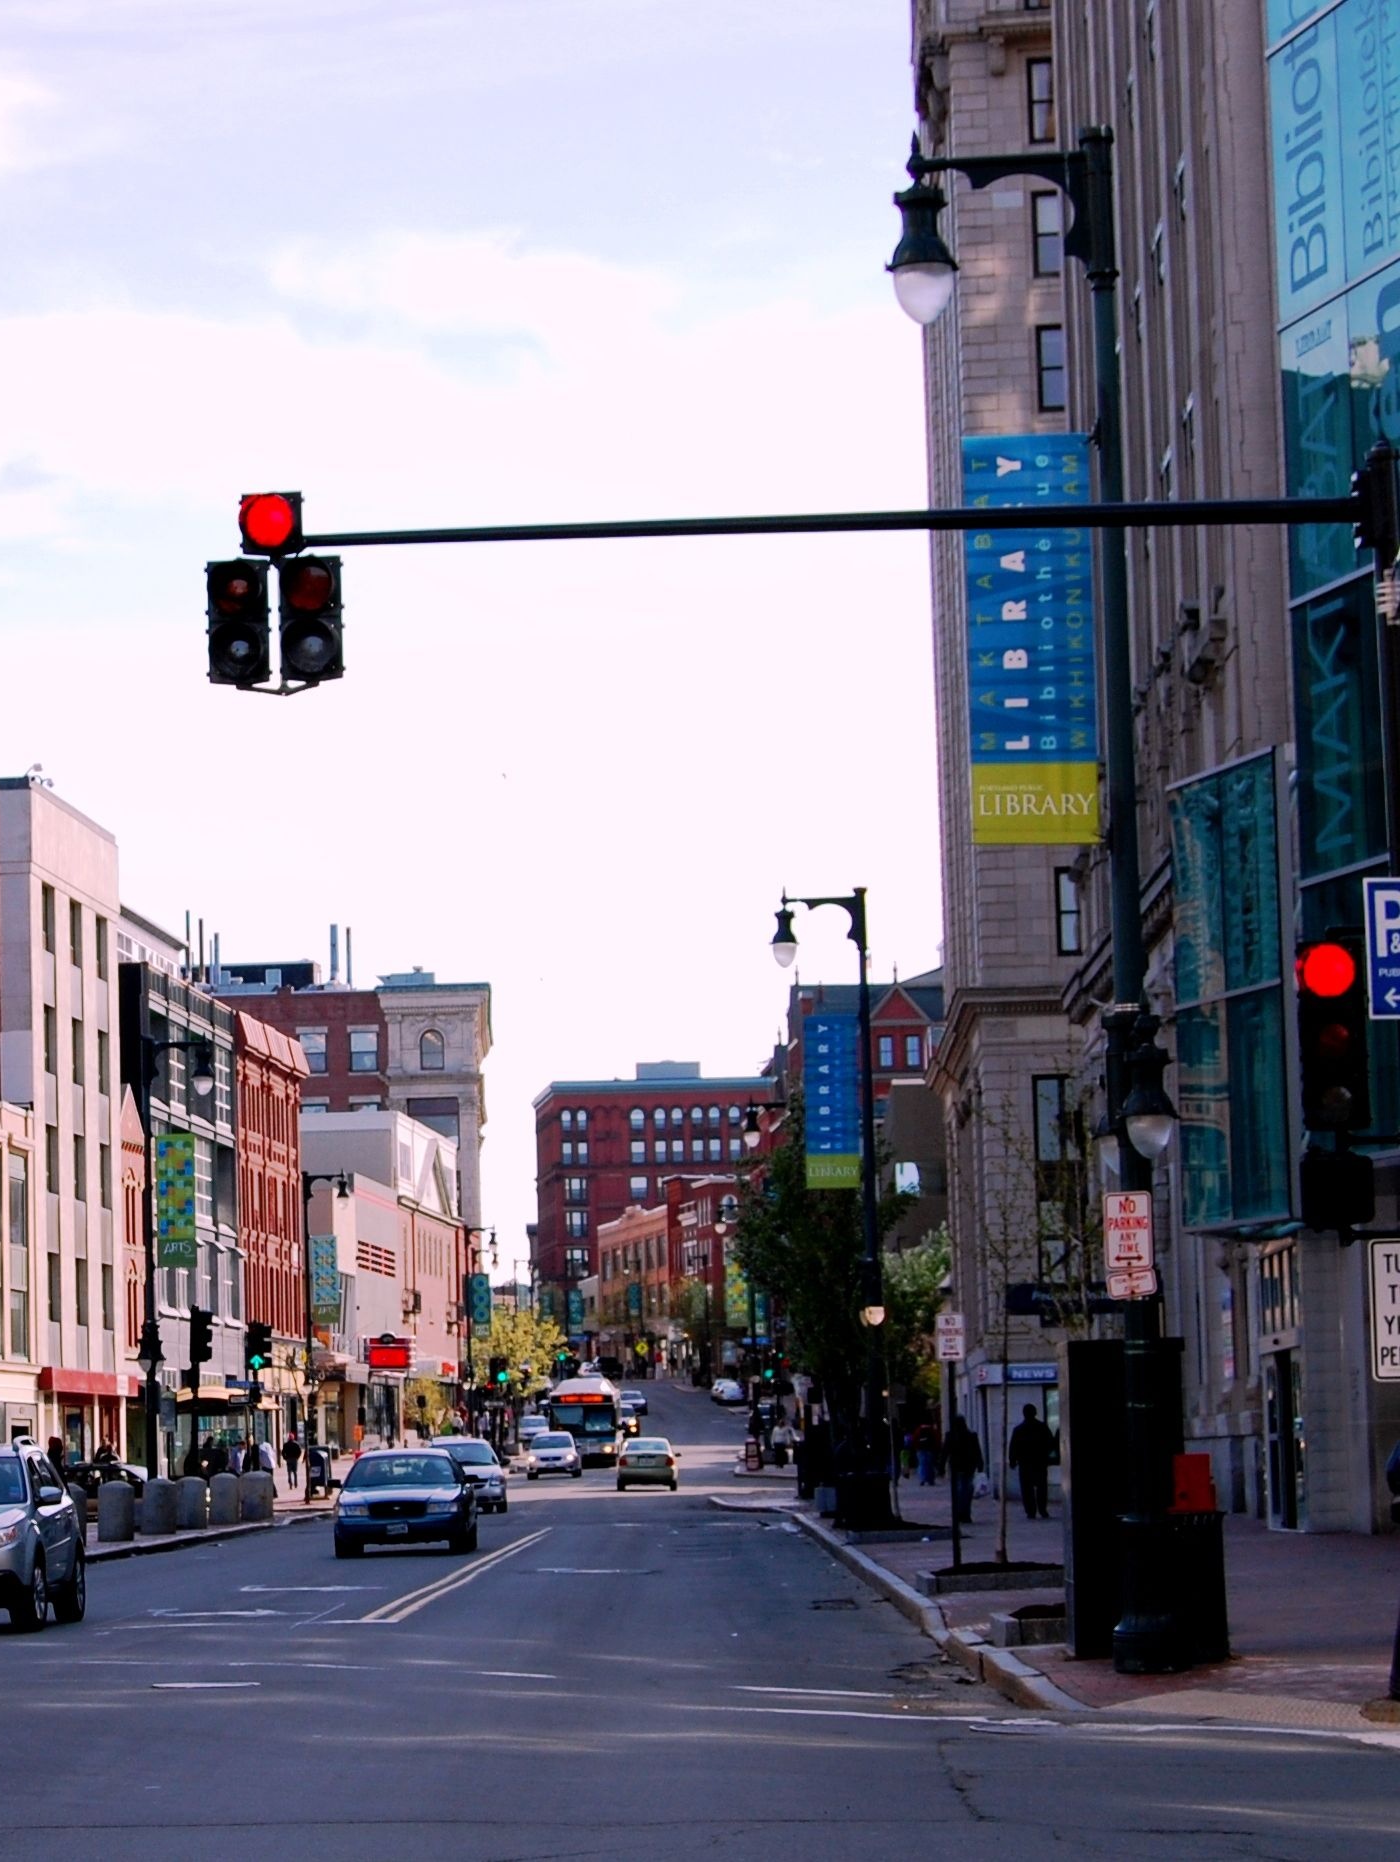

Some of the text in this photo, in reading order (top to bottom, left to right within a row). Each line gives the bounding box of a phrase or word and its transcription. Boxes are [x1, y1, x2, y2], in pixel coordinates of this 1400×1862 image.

[996, 456, 1030, 750] LIBRAY
[1035, 455, 1057, 750] Bibliothèue
[1062, 455, 1087, 750] WIKHIKONIKUAM
[979, 794, 1095, 816] LIBRARY
[817, 1024, 831, 1149] LIBRARY
[808, 1166, 859, 1177] LIBRARY
[1119, 1201, 1136, 1214] NO
[1107, 1216, 1149, 1231] PARKING
[1120, 1232, 1137, 1241] ANY
[163, 1240, 192, 1254] ARTS
[1118, 1244, 1140, 1253] TIME
[1011, 1368, 1055, 1379] NEWS
